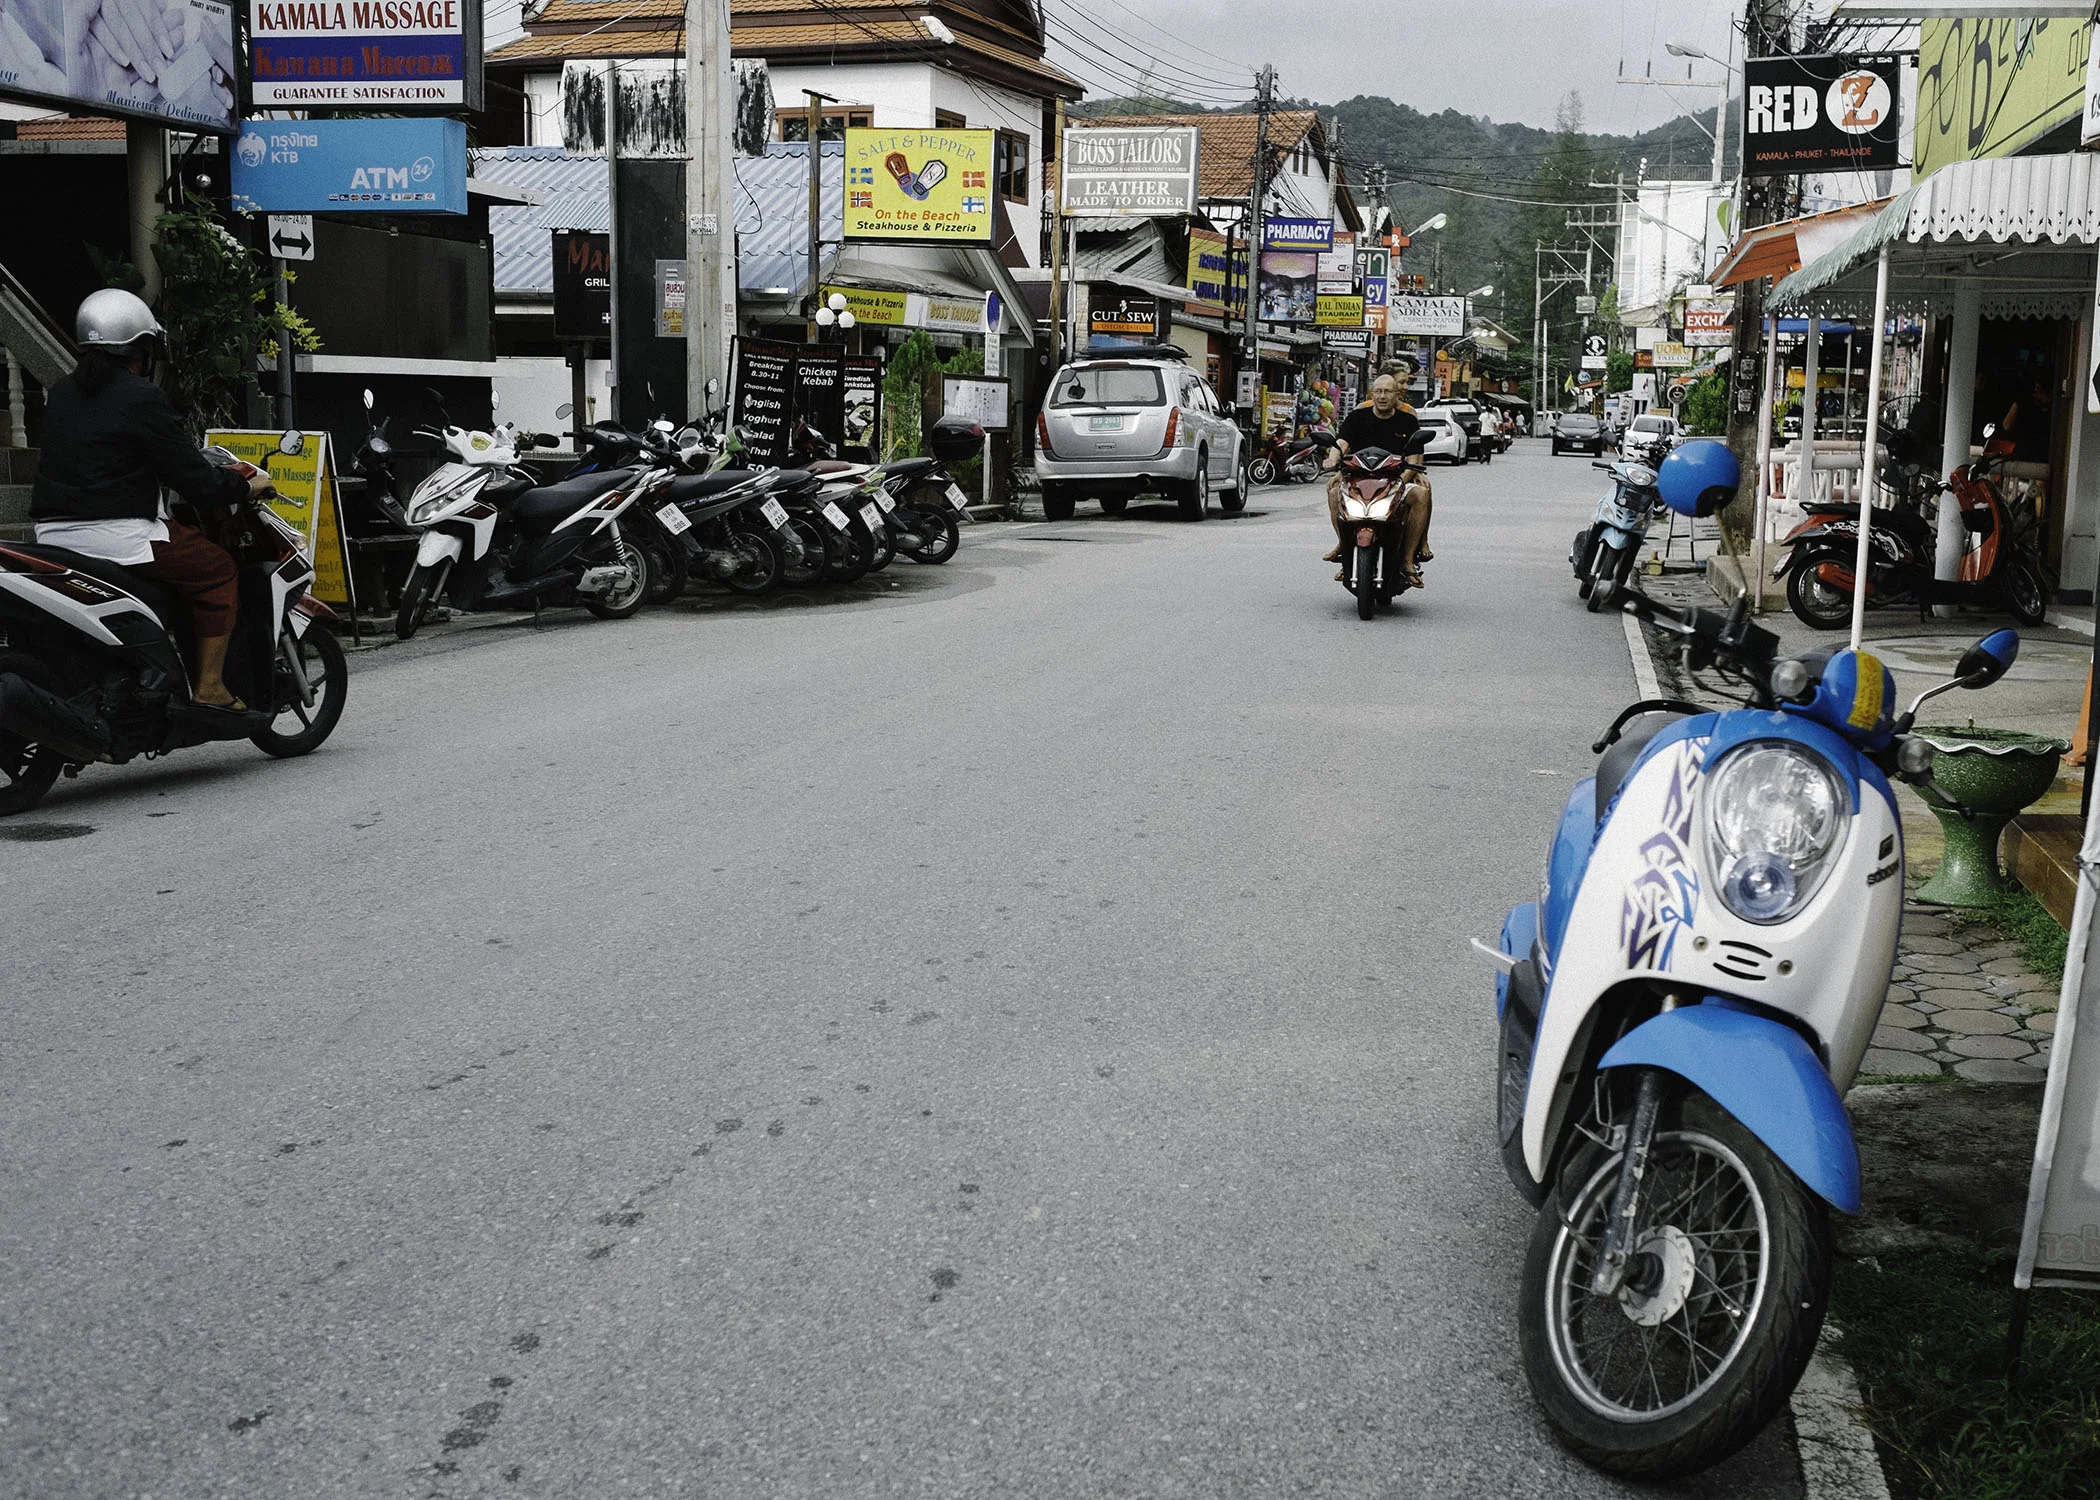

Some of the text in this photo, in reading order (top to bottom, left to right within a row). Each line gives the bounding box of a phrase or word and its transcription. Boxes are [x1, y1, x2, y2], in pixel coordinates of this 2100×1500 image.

[258, 1, 458, 31] KAMALA MASSAGE
[273, 87, 446, 100] GUARANTEE SATISFACTION
[106, 89, 215, 124] Manicure Pedicure
[1748, 85, 1819, 134] RED
[270, 132, 318, 153] กรุงไทย
[857, 135, 977, 163] SALT & PEPPER
[1077, 137, 1182, 164] BOSS TAILORS
[1755, 151, 1788, 161] KAMALA
[1794, 149, 1823, 159] PHUKET
[271, 151, 299, 164] KTB
[350, 167, 409, 189] ATM
[1084, 181, 1170, 195] LEATHER
[1070, 196, 1184, 207] MADE TO ORDER
[875, 209, 960, 221] On the Beach
[856, 220, 977, 232] Steakhouse & Pizzeria
[1267, 224, 1331, 240] PHARMACY
[845, 295, 874, 307] eakhouse
[881, 299, 904, 309] Pizzeria
[1318, 301, 1361, 310] YAL INDIAN
[1392, 299, 1460, 309] KAMALA
[859, 309, 870, 319] the
[872, 309, 892, 320] Beach
[930, 302, 949, 319] BOSS
[1091, 310, 1120, 321] CUT
[1126, 312, 1154, 322] SEW
[1323, 331, 1369, 341] PHARMACY
[749, 361, 784, 372] Breakfast
[799, 367, 837, 377] Chicken
[751, 370, 779, 380] 8.30-11
[802, 376, 834, 386] Kebab
[744, 382, 786, 394] Choose from:
[749, 399, 781, 410] nglish
[743, 413, 782, 426] Yoghurt
[749, 445, 771, 457] Thai
[283, 467, 316, 484] Massage
